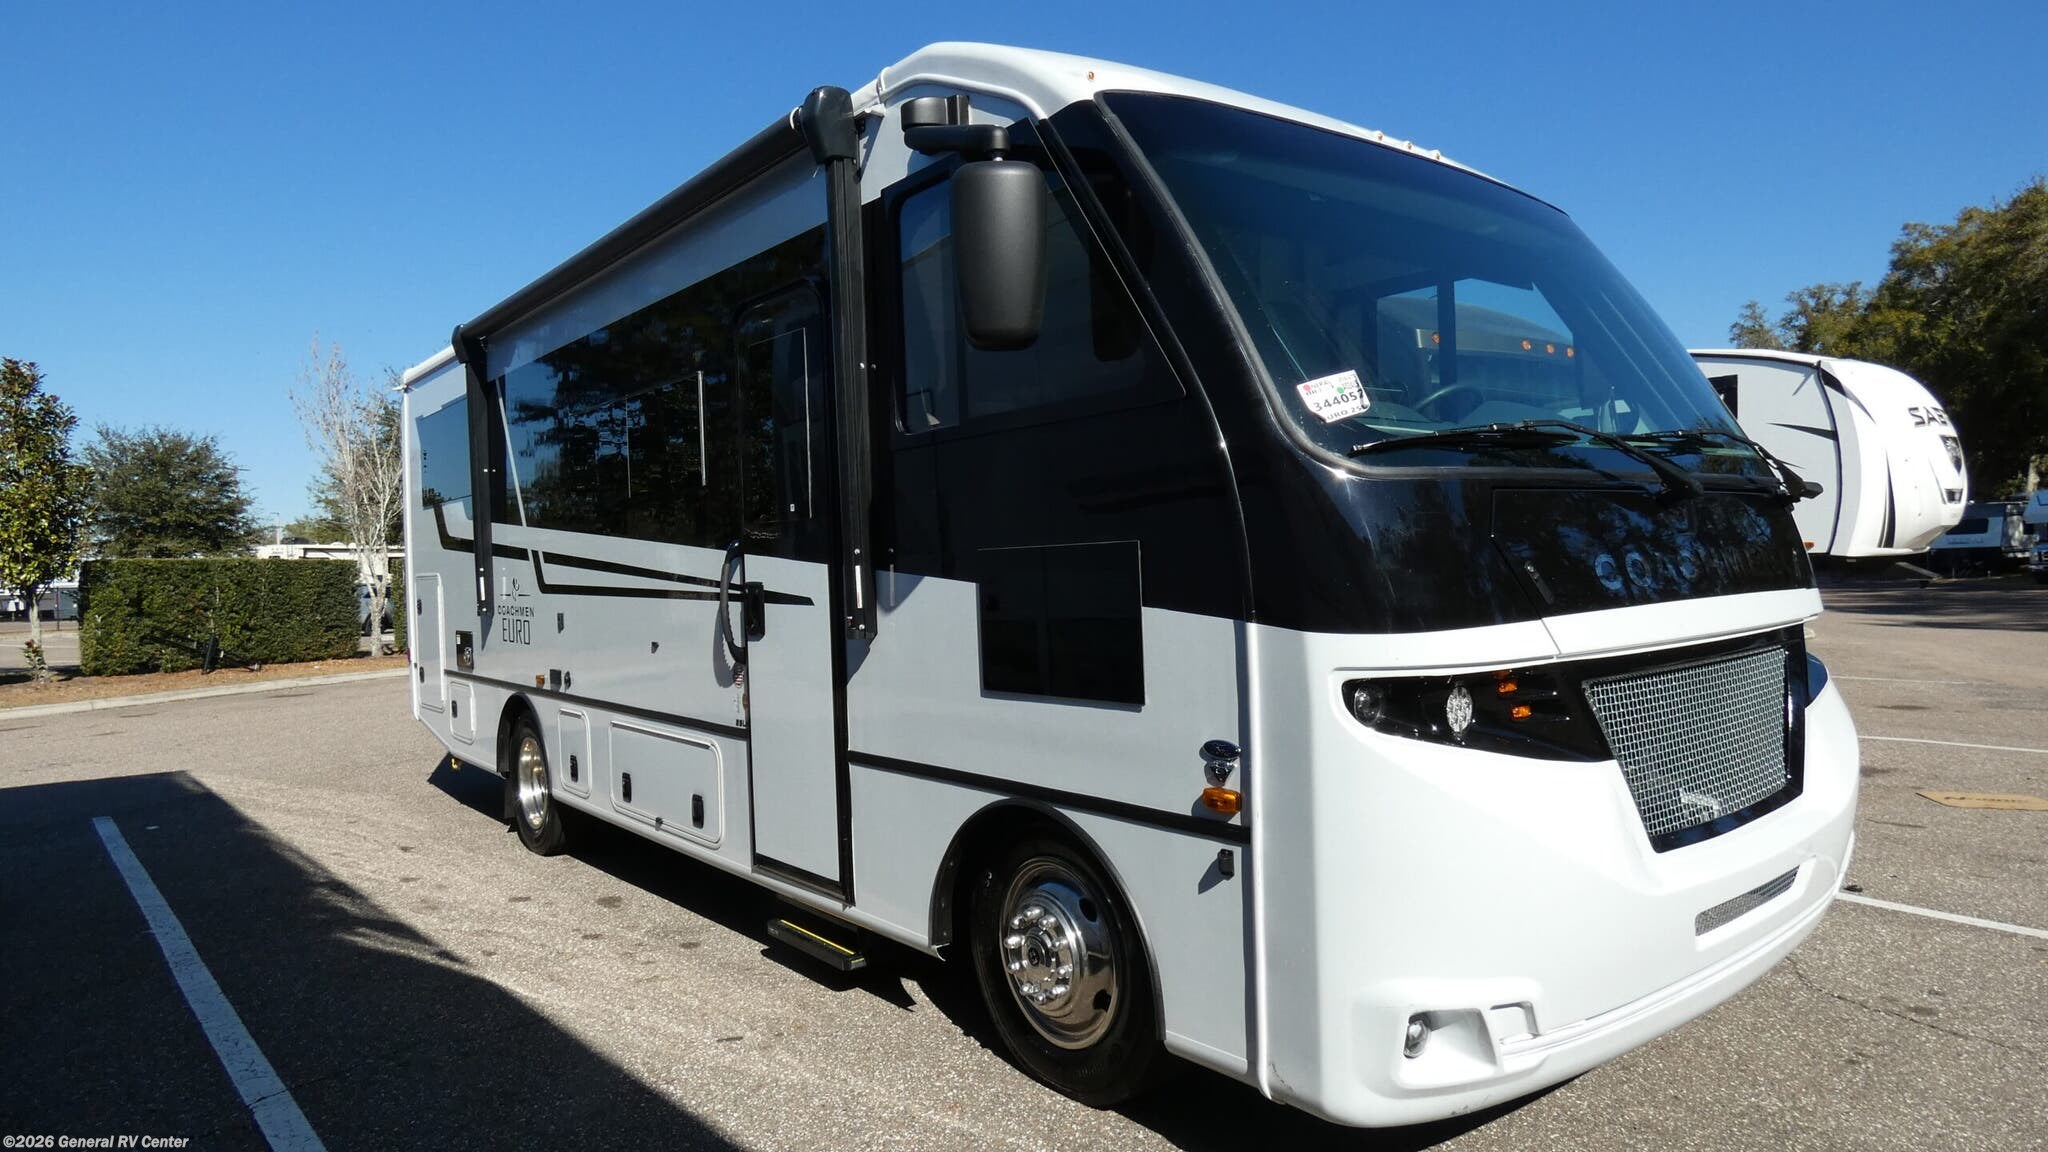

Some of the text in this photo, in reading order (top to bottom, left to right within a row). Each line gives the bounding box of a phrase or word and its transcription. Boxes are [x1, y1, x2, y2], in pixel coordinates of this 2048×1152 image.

[1326, 409, 1348, 420] URO
[497, 604, 535, 617] COACHMEN
[502, 617, 531, 645] EURO
